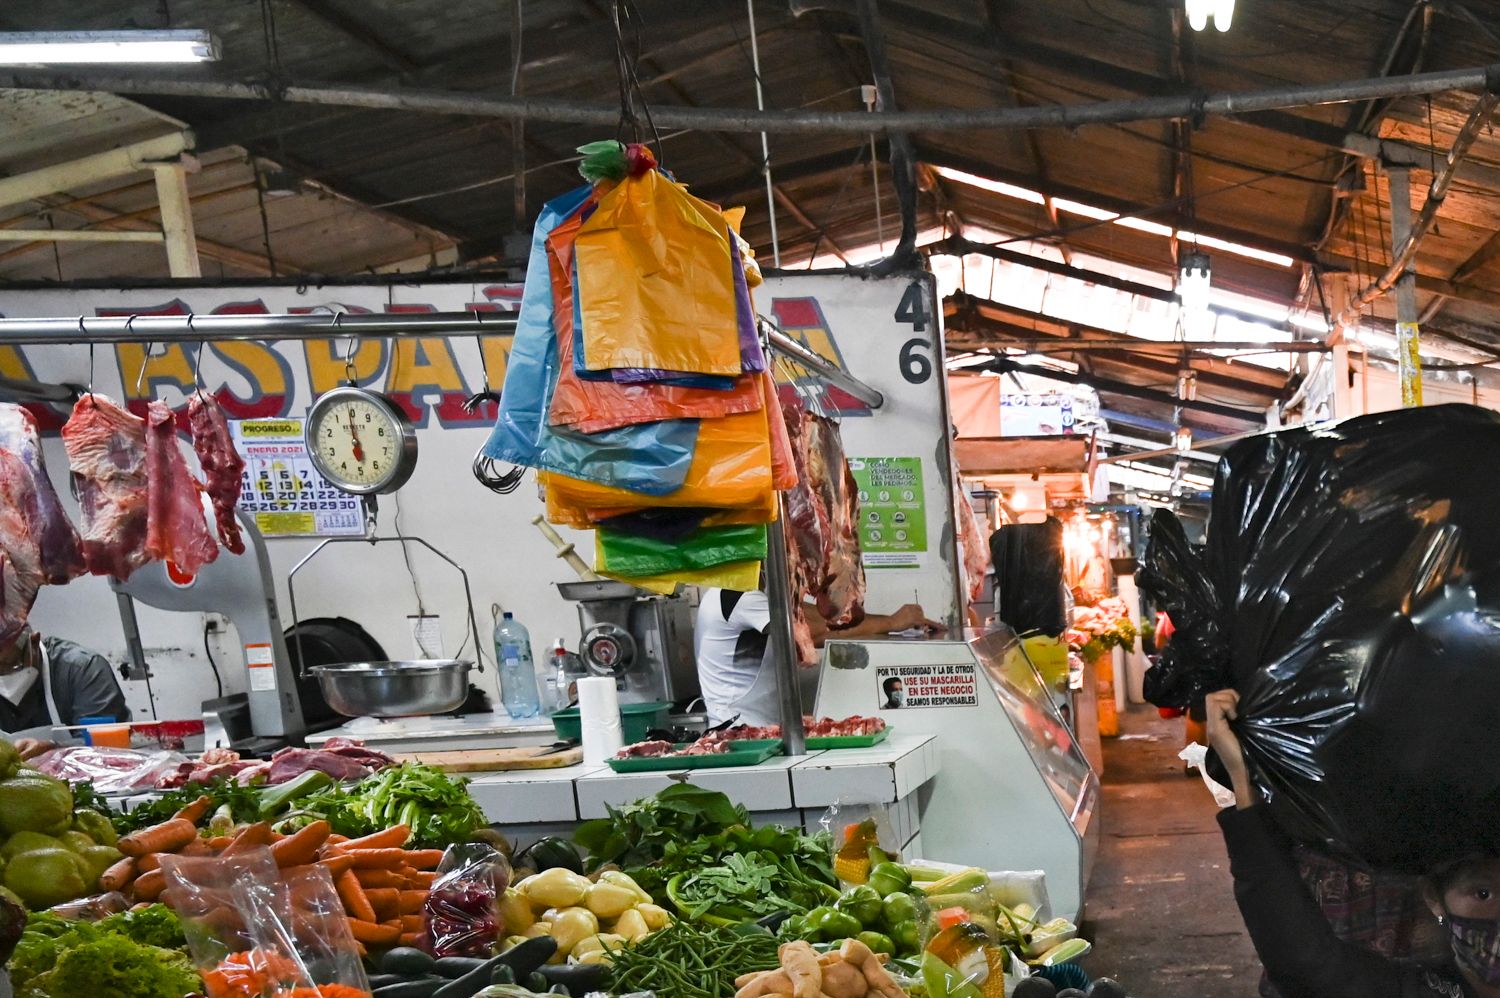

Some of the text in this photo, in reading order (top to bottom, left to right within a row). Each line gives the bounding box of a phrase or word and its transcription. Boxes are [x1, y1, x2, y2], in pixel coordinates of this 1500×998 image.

[365, 413, 371, 422] 9
[327, 428, 333, 437] 2
[378, 428, 384, 437] 8
[329, 447, 335, 456] 3
[382, 447, 388, 456] 7
[341, 461, 347, 470] 4
[373, 461, 379, 469] 6
[260, 471, 269, 479] 5
[279, 471, 289, 479] 6
[300, 470, 308, 479] 7
[357, 466, 364, 475] 5
[260, 481, 272, 490] 12
[280, 481, 293, 490] 13
[299, 480, 313, 489] 14
[241, 492, 254, 501] 18
[261, 492, 274, 501] 19
[279, 492, 297, 500] 20
[301, 491, 314, 500] 21
[318, 491, 336, 499] 22
[241, 501, 356, 512] 25 26 27 28 29 30
[877, 665, 974, 676] POR TU SEGURIDAD Y LA DE OTROS
[904, 675, 974, 685] USE SU MASCARILLA
[909, 685, 973, 696] EN ESTE NEGOCIO
[906, 696, 976, 706] SEAMOS RESPONSABLES
